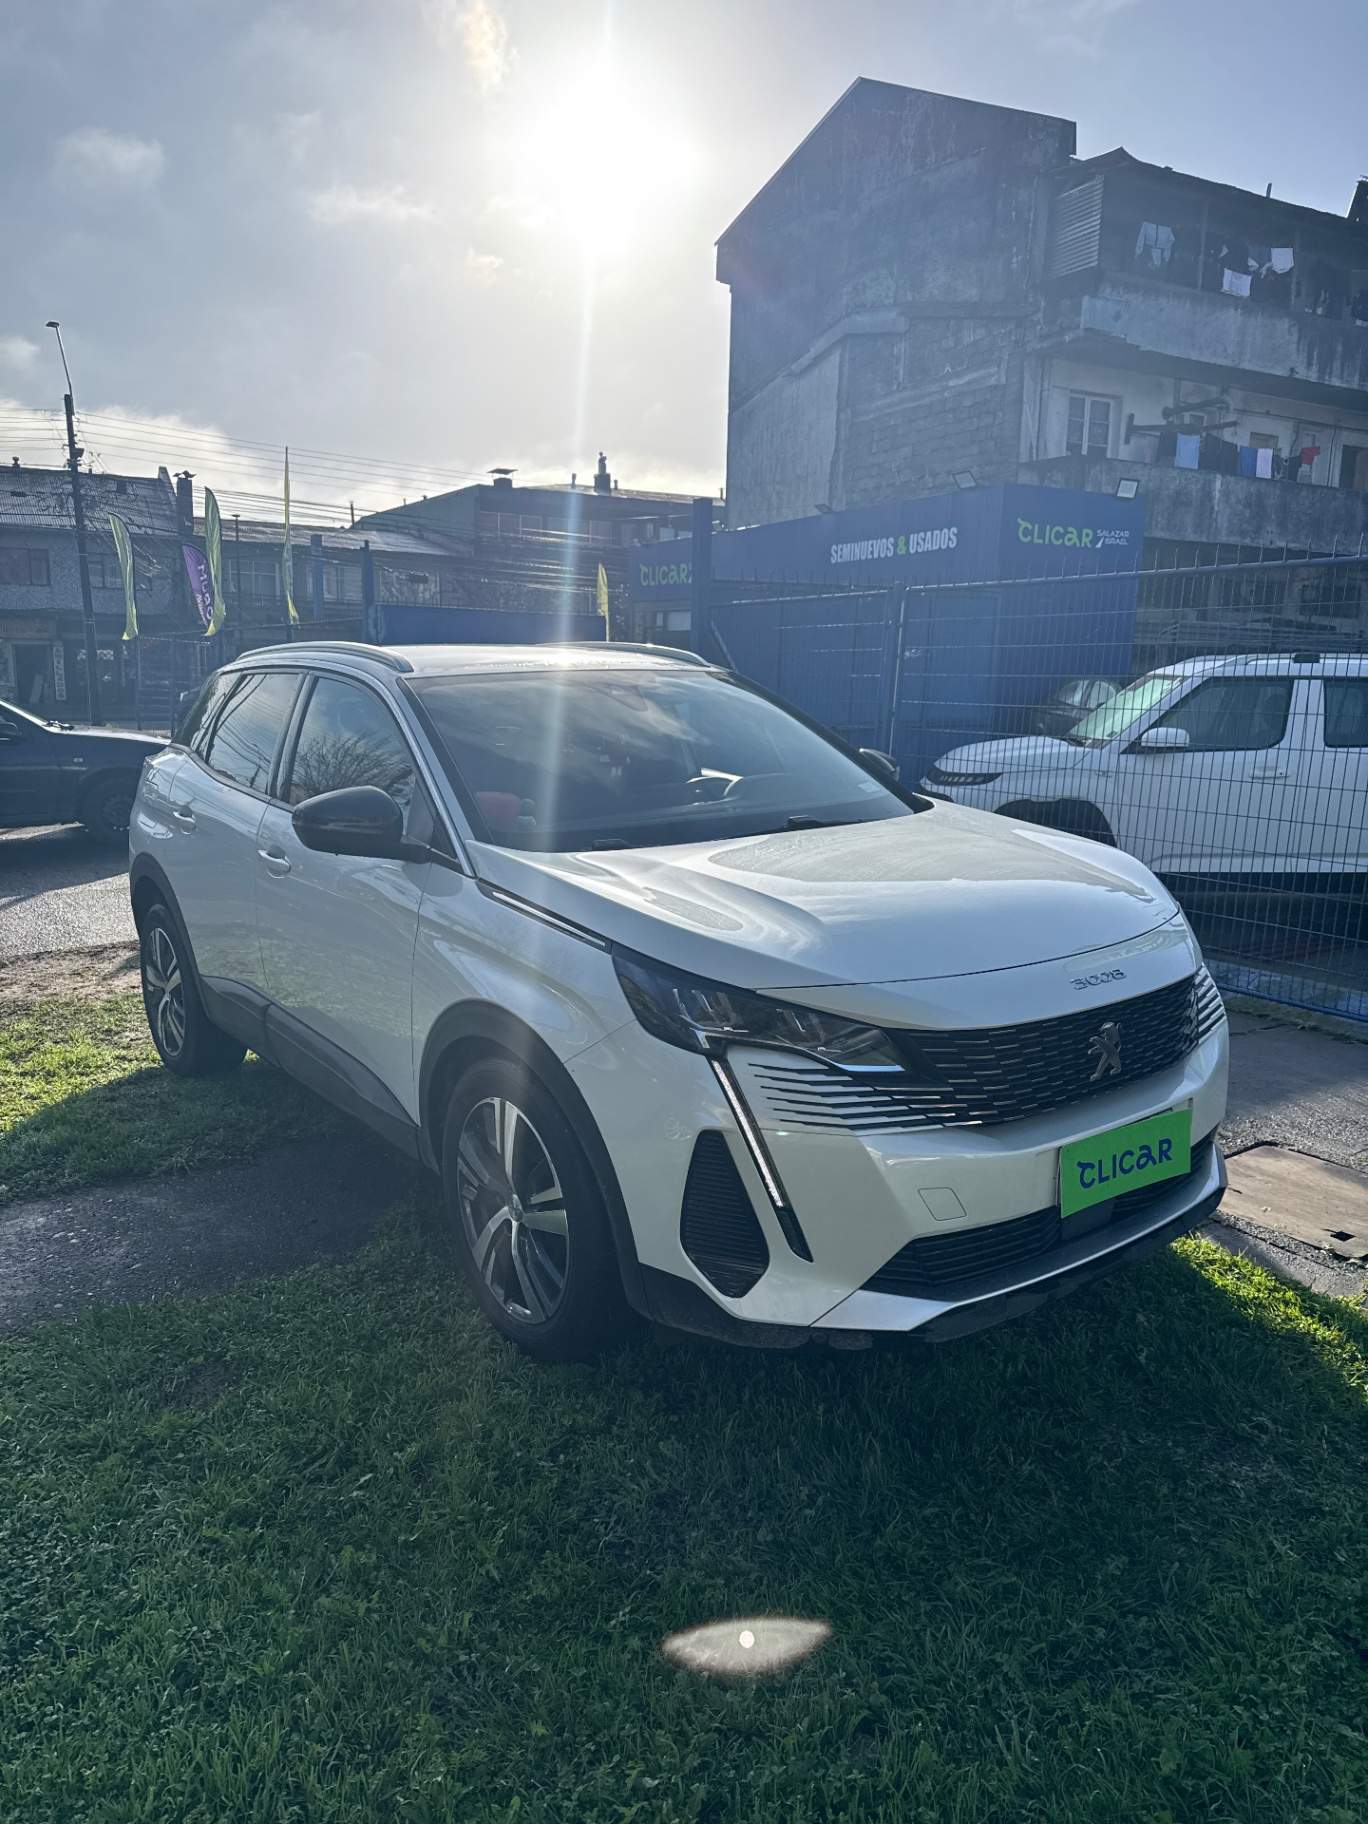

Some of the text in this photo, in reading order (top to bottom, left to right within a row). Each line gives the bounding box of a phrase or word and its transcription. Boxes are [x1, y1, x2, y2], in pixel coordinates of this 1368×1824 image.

[830, 527, 958, 564] SEMINUEVOS & USADOS
[1069, 969, 1127, 991] 3008
